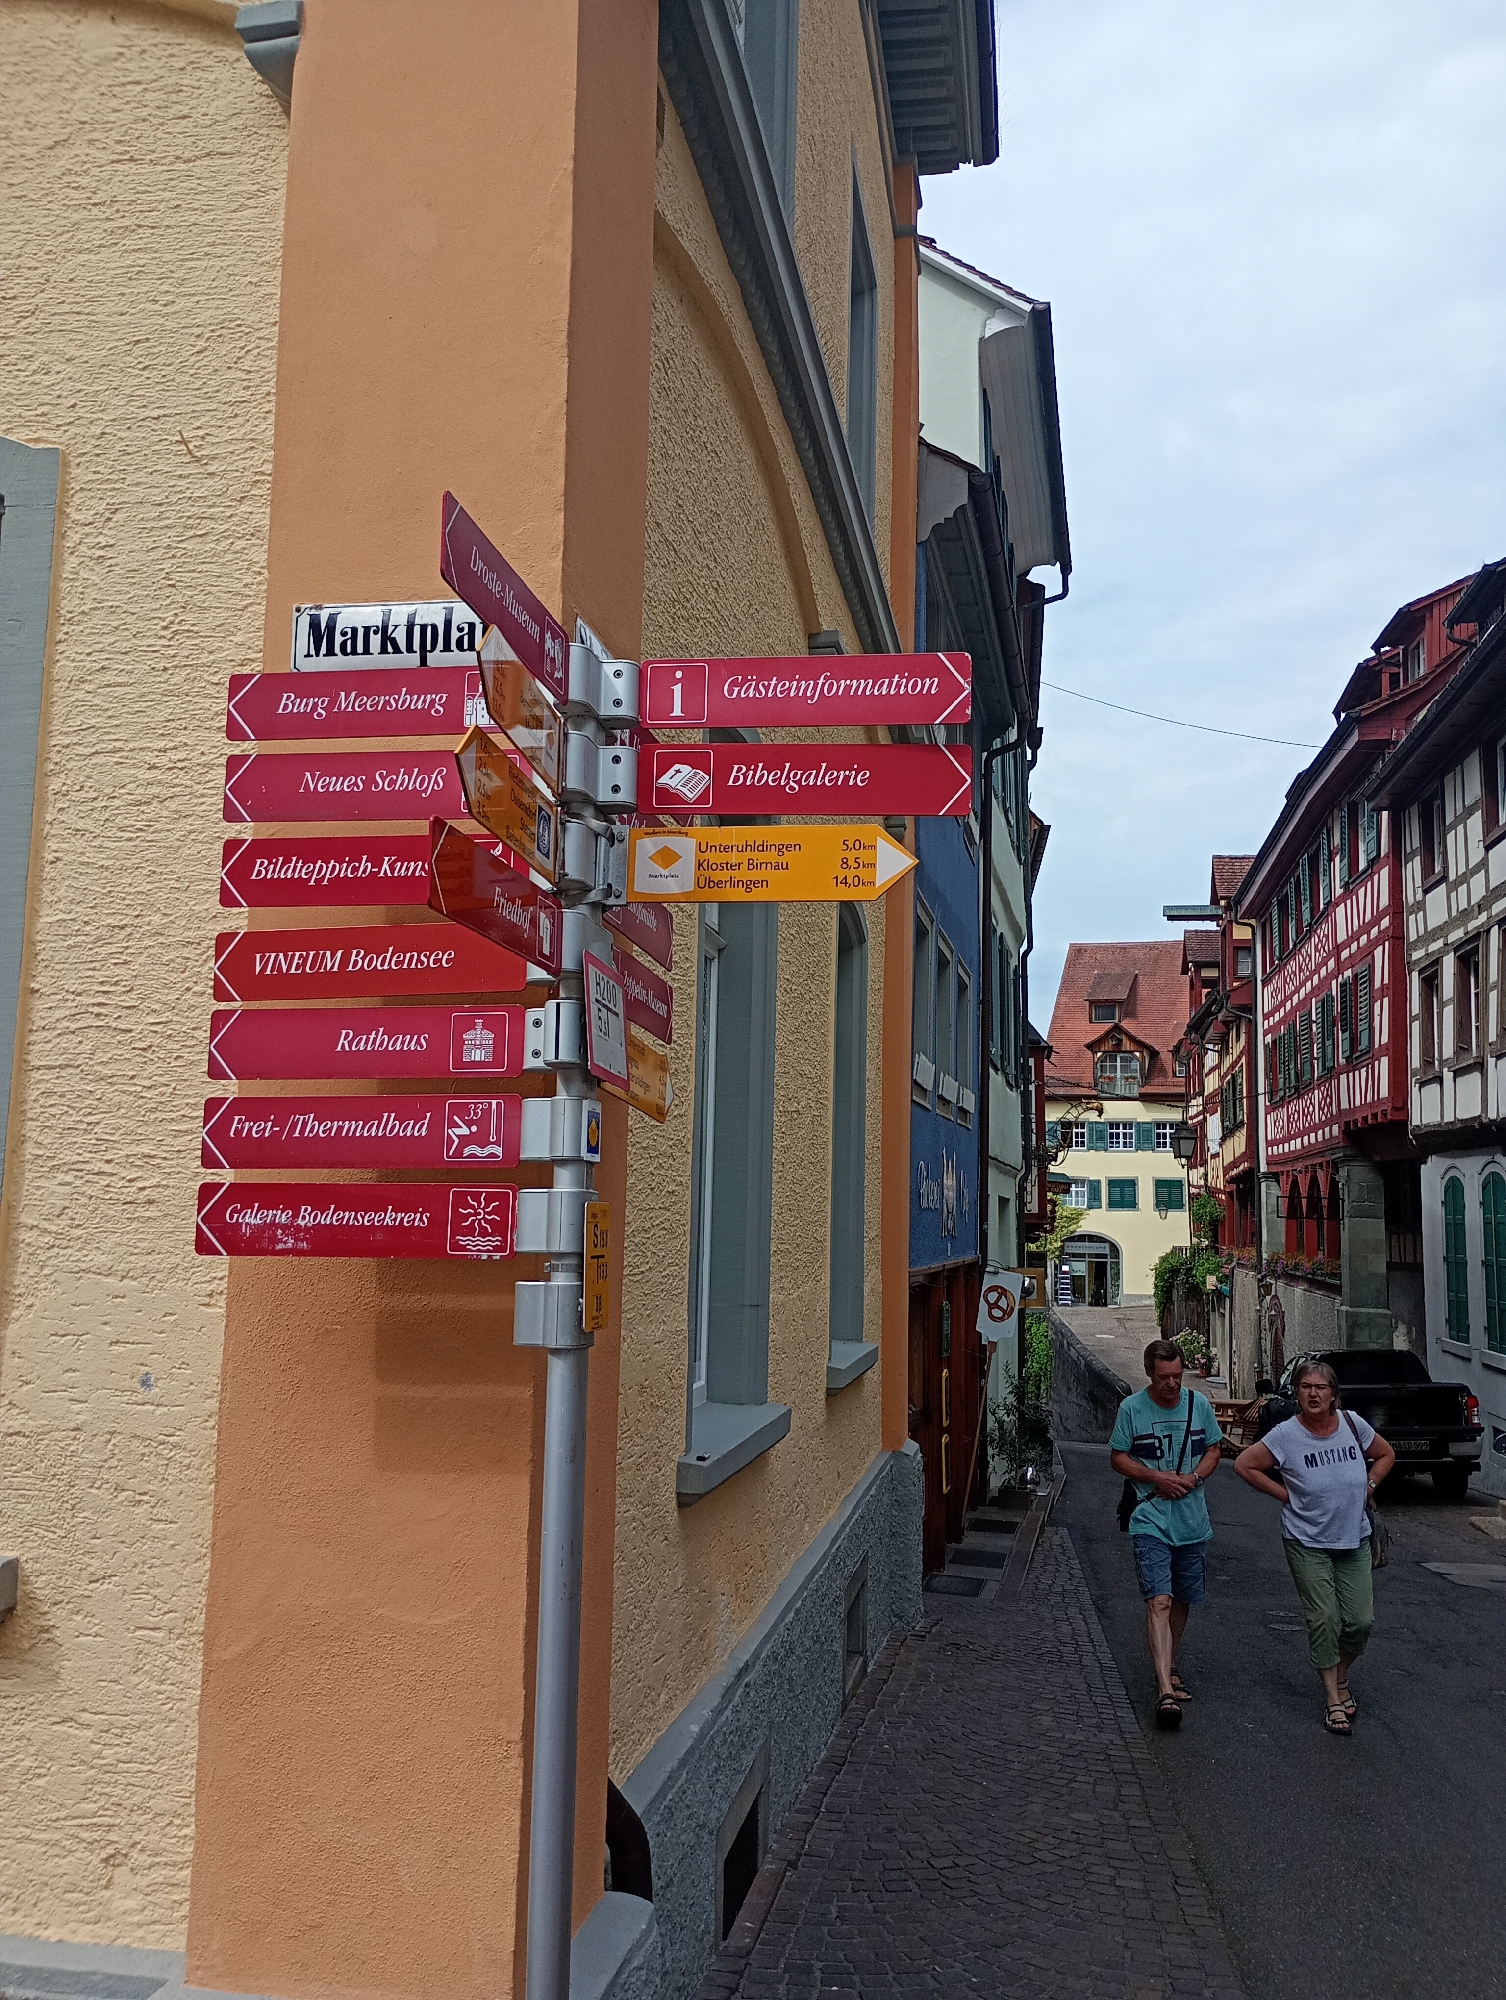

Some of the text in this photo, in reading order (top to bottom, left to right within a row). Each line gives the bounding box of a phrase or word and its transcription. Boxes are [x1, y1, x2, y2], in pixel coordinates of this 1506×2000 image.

[470, 544, 541, 644] Droste-Museum
[303, 606, 486, 667] Marktpla
[723, 673, 939, 703] Gästeinformation
[277, 687, 448, 719] Burg Meersburg
[299, 767, 447, 797] Neues Schloß
[727, 763, 870, 793] Bibelgalerie
[698, 840, 801, 857] Unteruhldingen
[250, 856, 428, 885] Bildteppich-Kuns
[697, 858, 743, 872] Kloster
[747, 858, 789, 871] Birnau
[696, 873, 769, 893] Überlingen
[494, 886, 534, 939] Friedhof
[253, 947, 455, 975] VINEUM Bodensee
[595, 970, 617, 1009] H200
[335, 1028, 429, 1053] Rathaus
[225, 1203, 430, 1228] Galerie Bodenseekreis
[1304, 1446, 1357, 1469] MUSTANG
